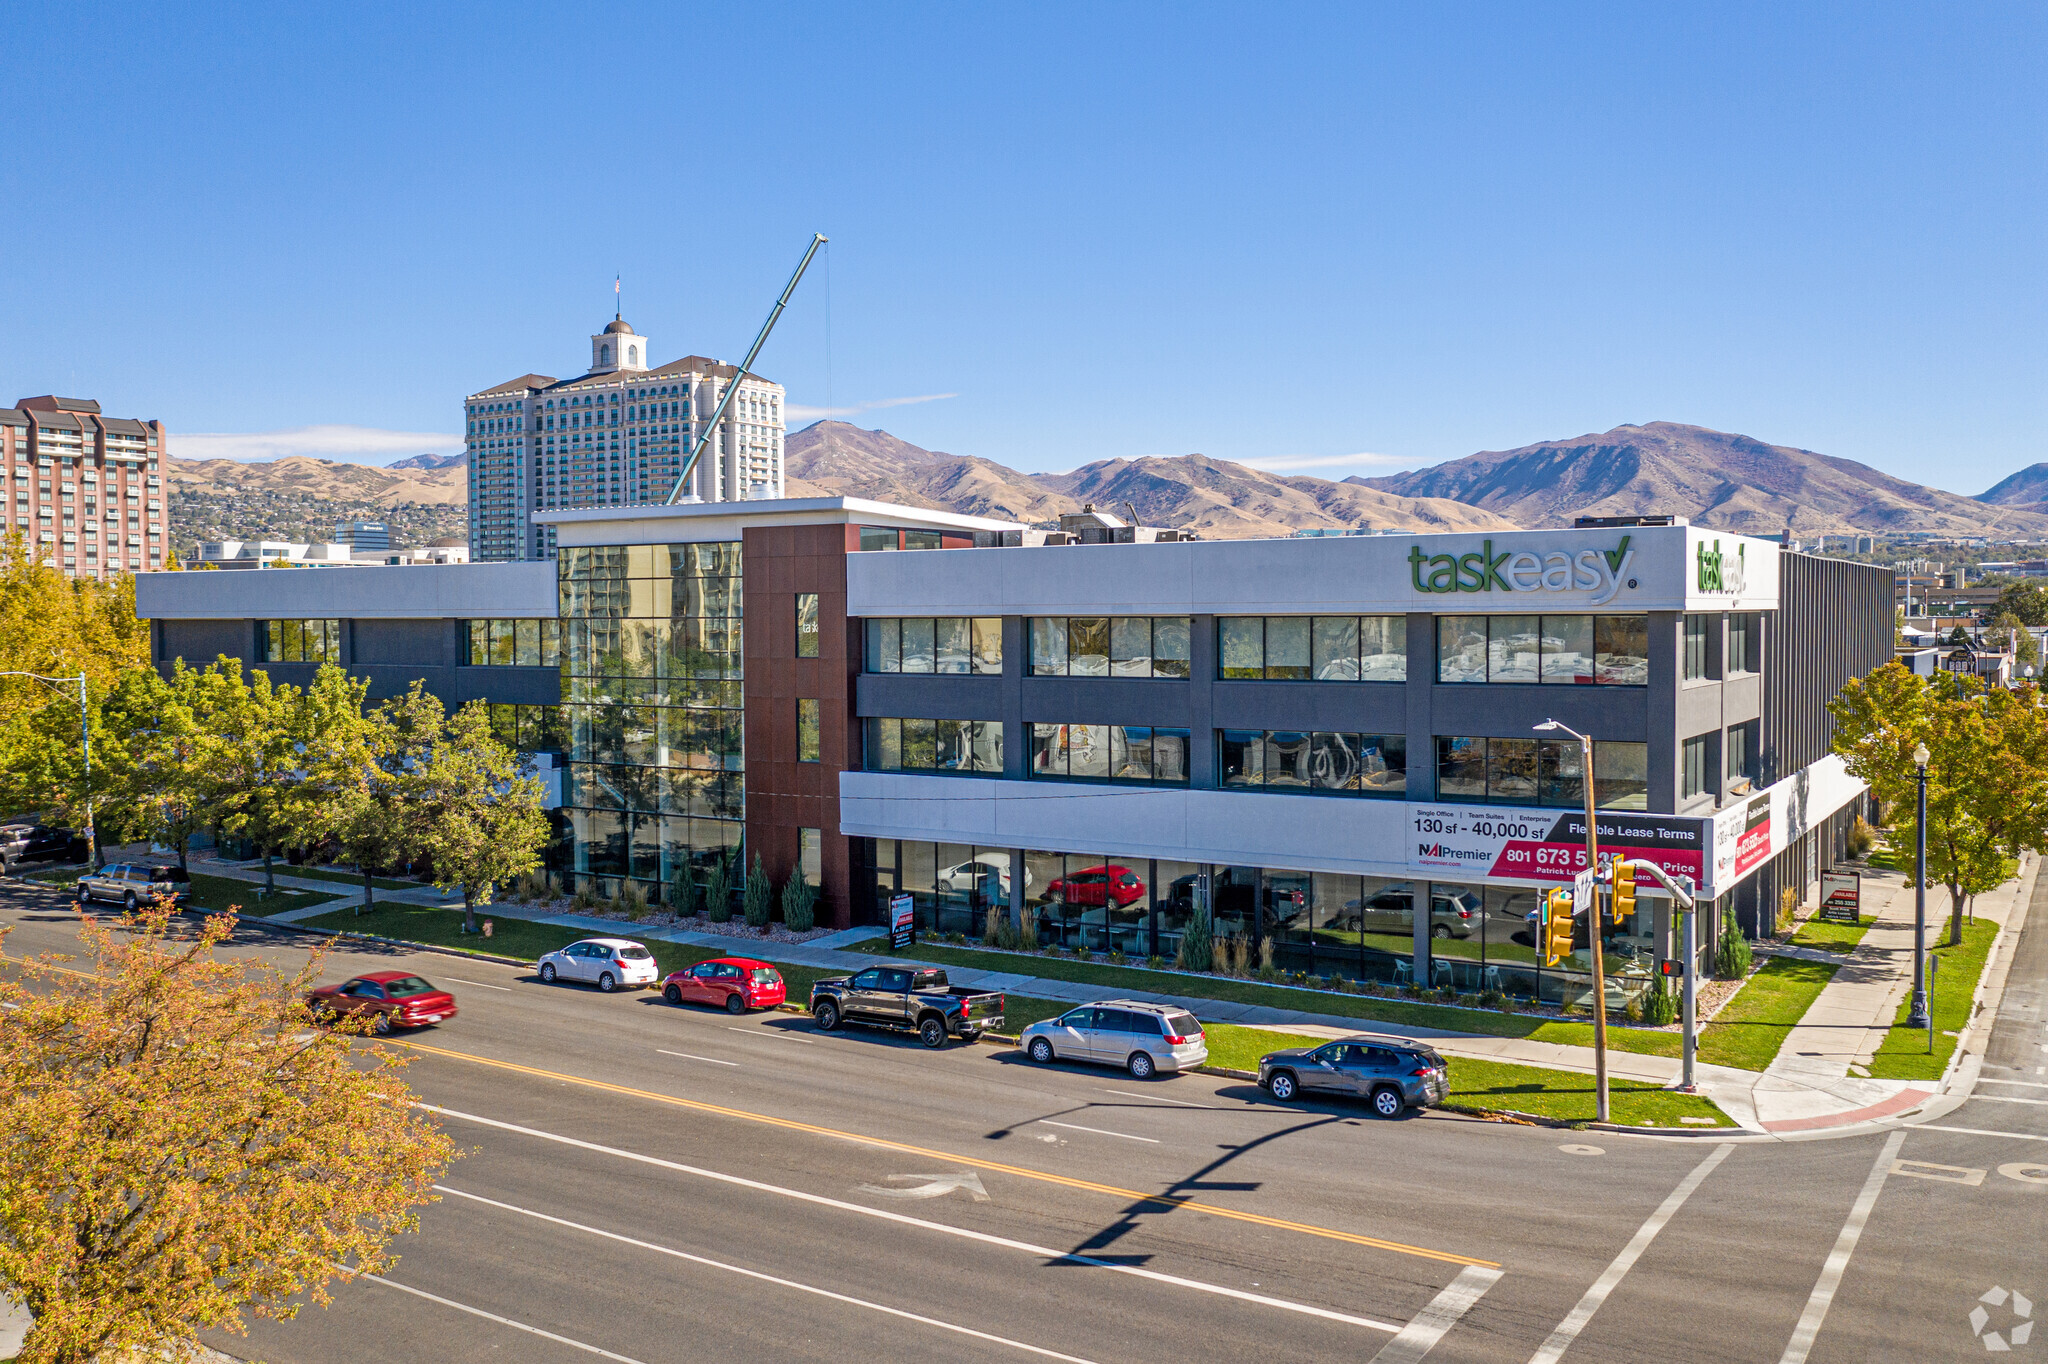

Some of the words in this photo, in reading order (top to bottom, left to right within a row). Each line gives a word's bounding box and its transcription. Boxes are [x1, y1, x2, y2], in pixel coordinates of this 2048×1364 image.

[1408, 536, 1634, 606] taskeasy
[1414, 818, 1442, 833] 130
[1446, 824, 1458, 834] sf
[1472, 822, 1528, 839] 40,000
[1532, 828, 1544, 839] sf
[1618, 826, 1654, 838] Lease
[1657, 828, 1695, 840] Terms
[1506, 850, 1531, 862] 801
[1536, 848, 1570, 866] 673
[1663, 862, 1695, 872] Price
[1536, 867, 1564, 875] Patrick
